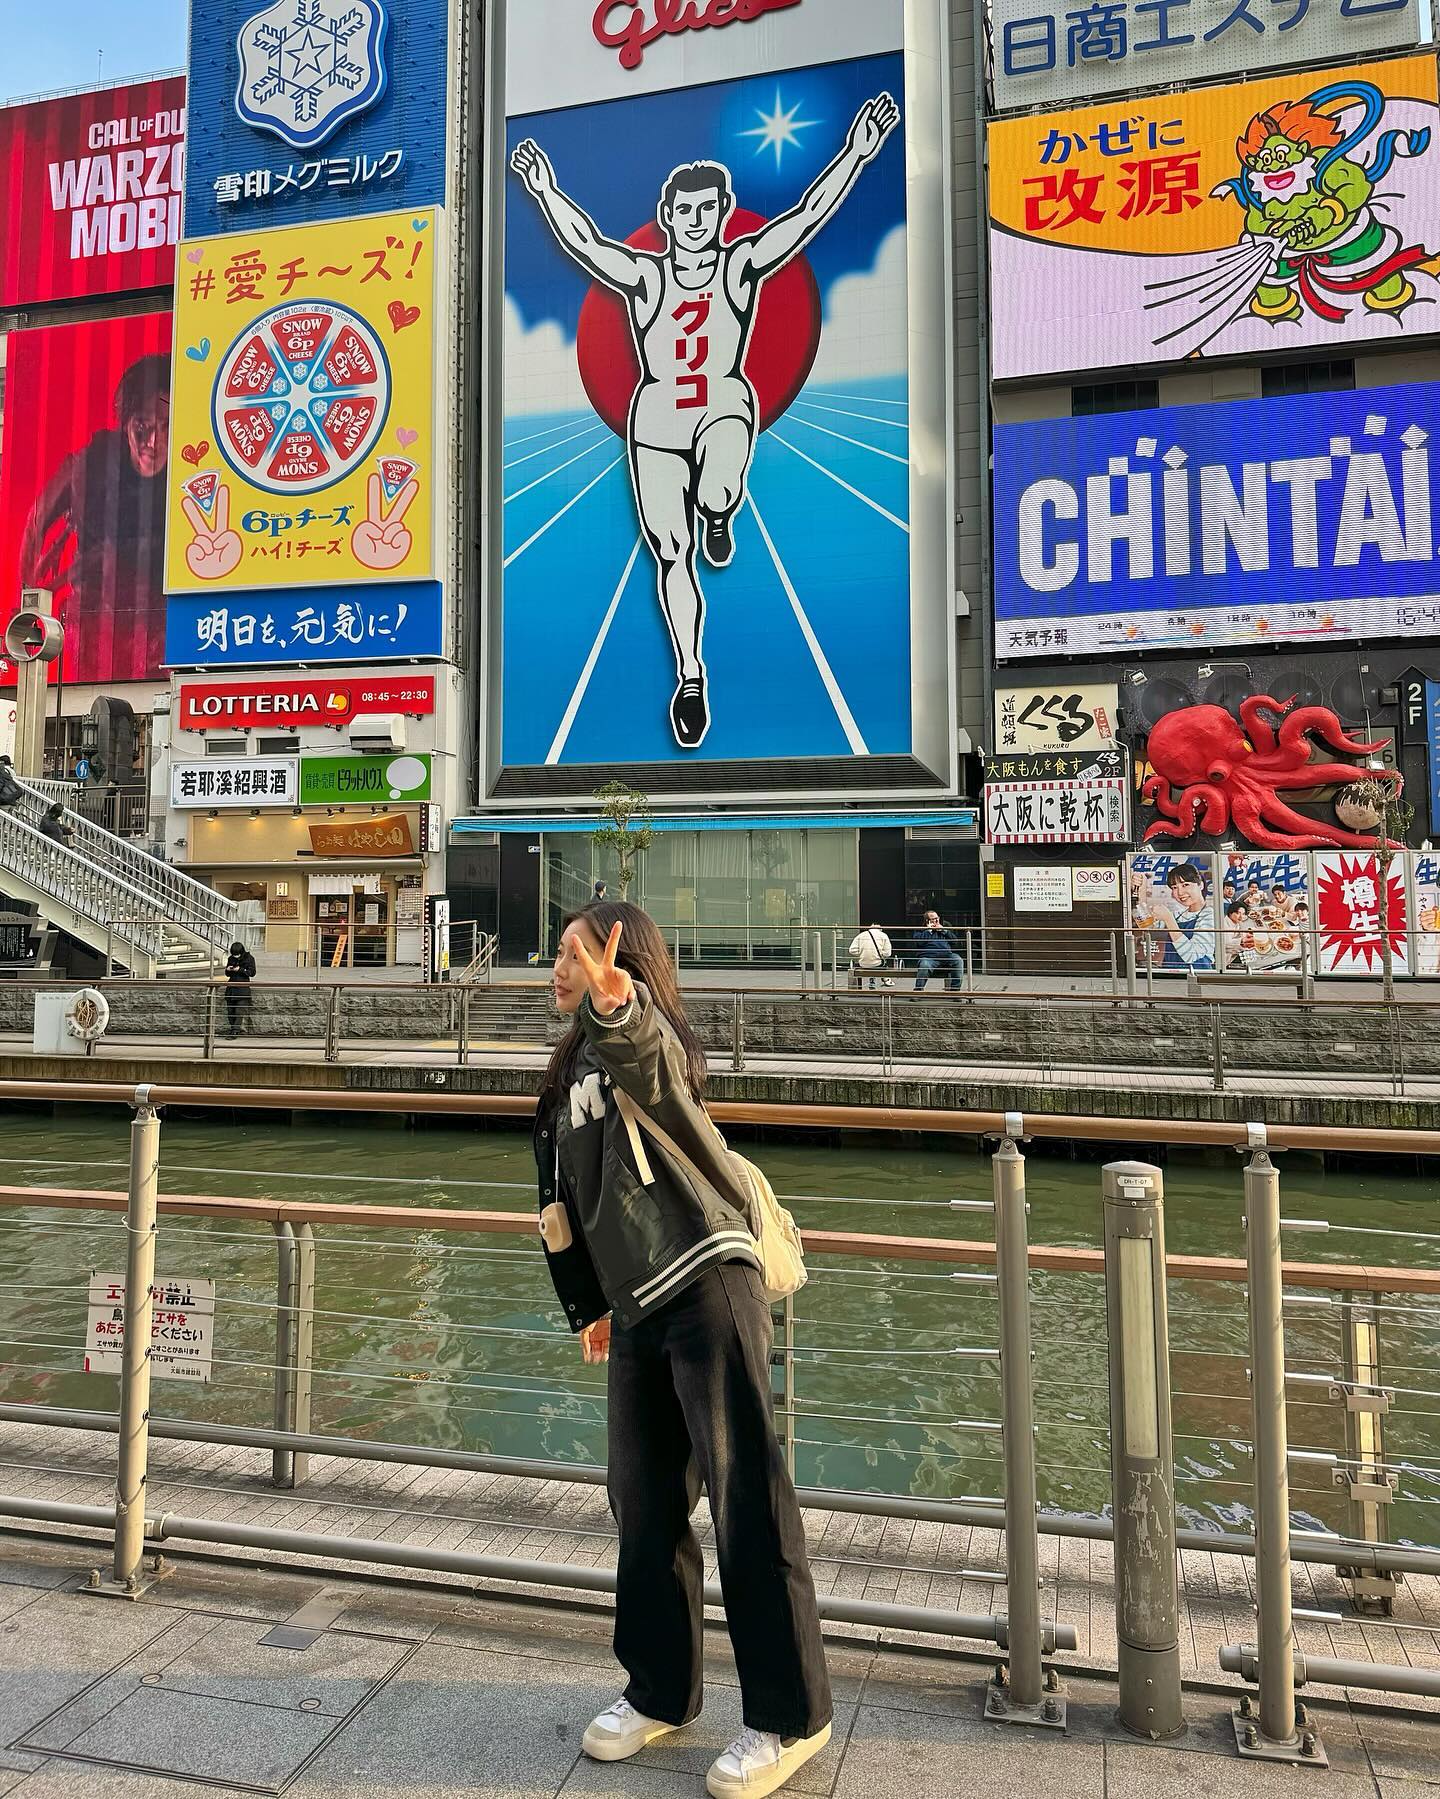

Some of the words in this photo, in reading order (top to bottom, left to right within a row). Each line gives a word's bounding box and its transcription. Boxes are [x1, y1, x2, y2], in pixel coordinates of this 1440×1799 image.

[88, 116, 142, 149] CALL
[139, 118, 154, 133] OF
[1037, 114, 1186, 165] かぜに
[213, 150, 403, 203] 雪印メグミルク
[1022, 150, 1202, 231] 改源
[282, 318, 324, 334] SNOW
[288, 350, 313, 360] CHEESE
[344, 336, 373, 375] SNOW
[671, 292, 714, 410] グリコ
[231, 344, 259, 388] SNOW
[259, 366, 276, 392] CHEESE
[325, 360, 342, 385] CHEESE
[258, 408, 274, 433] CHEESE
[325, 401, 342, 428] CHEESE
[228, 418, 256, 458] SNOW
[286, 434, 312, 444] CHEESE
[343, 406, 371, 451] SNOW
[277, 461, 318, 476] SNOW
[387, 462, 408, 473] SNOW
[192, 476, 213, 489] SNOW
[1019, 415, 1433, 592] CHINTAI
[1009, 628, 1068, 648] 天気予報
[188, 693, 320, 716] LOTTERIA
[1017, 693, 1094, 742] くくる
[986, 757, 1083, 779] 大阪もんを食す
[1104, 766, 1121, 778] 2F
[993, 790, 1105, 833] 大阪に乾杯
[1109, 795, 1120, 823] 検索
[569, 1073, 607, 1129] M
